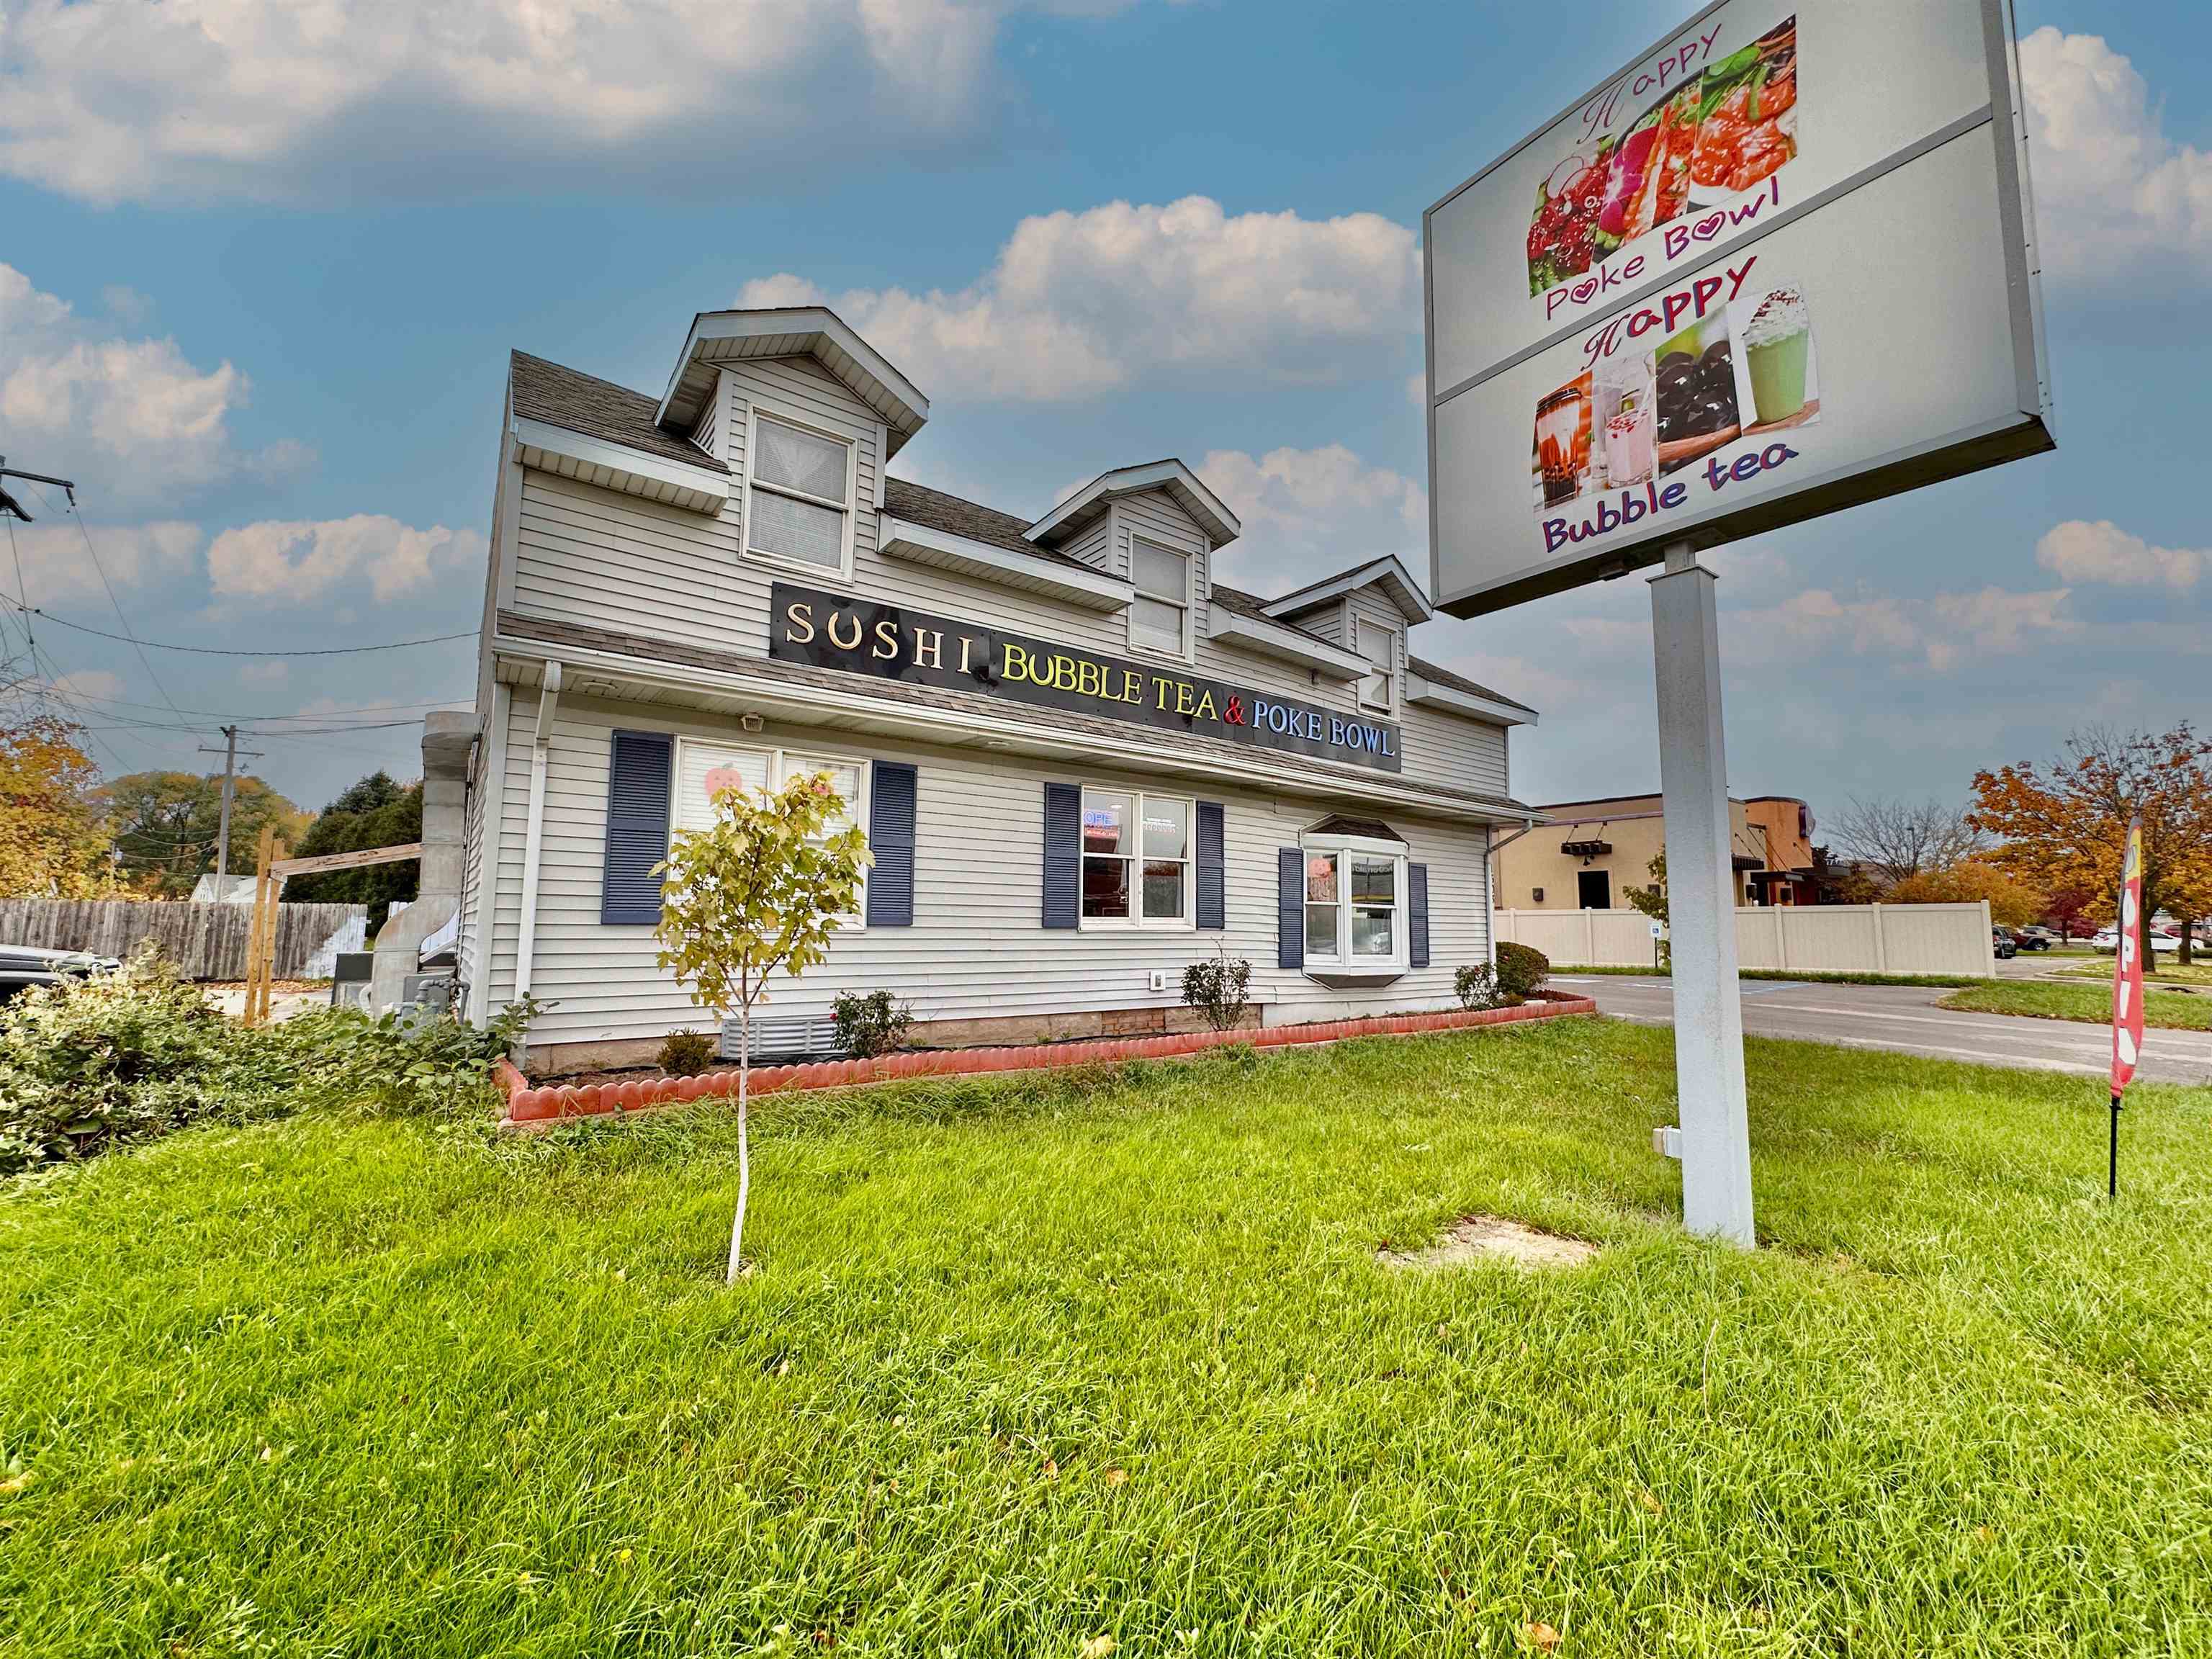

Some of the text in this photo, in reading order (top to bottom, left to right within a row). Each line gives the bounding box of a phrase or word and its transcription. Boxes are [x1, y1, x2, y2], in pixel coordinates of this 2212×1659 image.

[1546, 176, 1779, 320] Poke Bowl
[1542, 442, 1799, 554] Bubble tea
[1000, 642, 1142, 706] BUBBLE
[1151, 675, 1219, 721] TEA
[1223, 692, 1246, 727] &
[1251, 699, 1323, 741] POKE
[1330, 717, 1395, 757] BOWL
